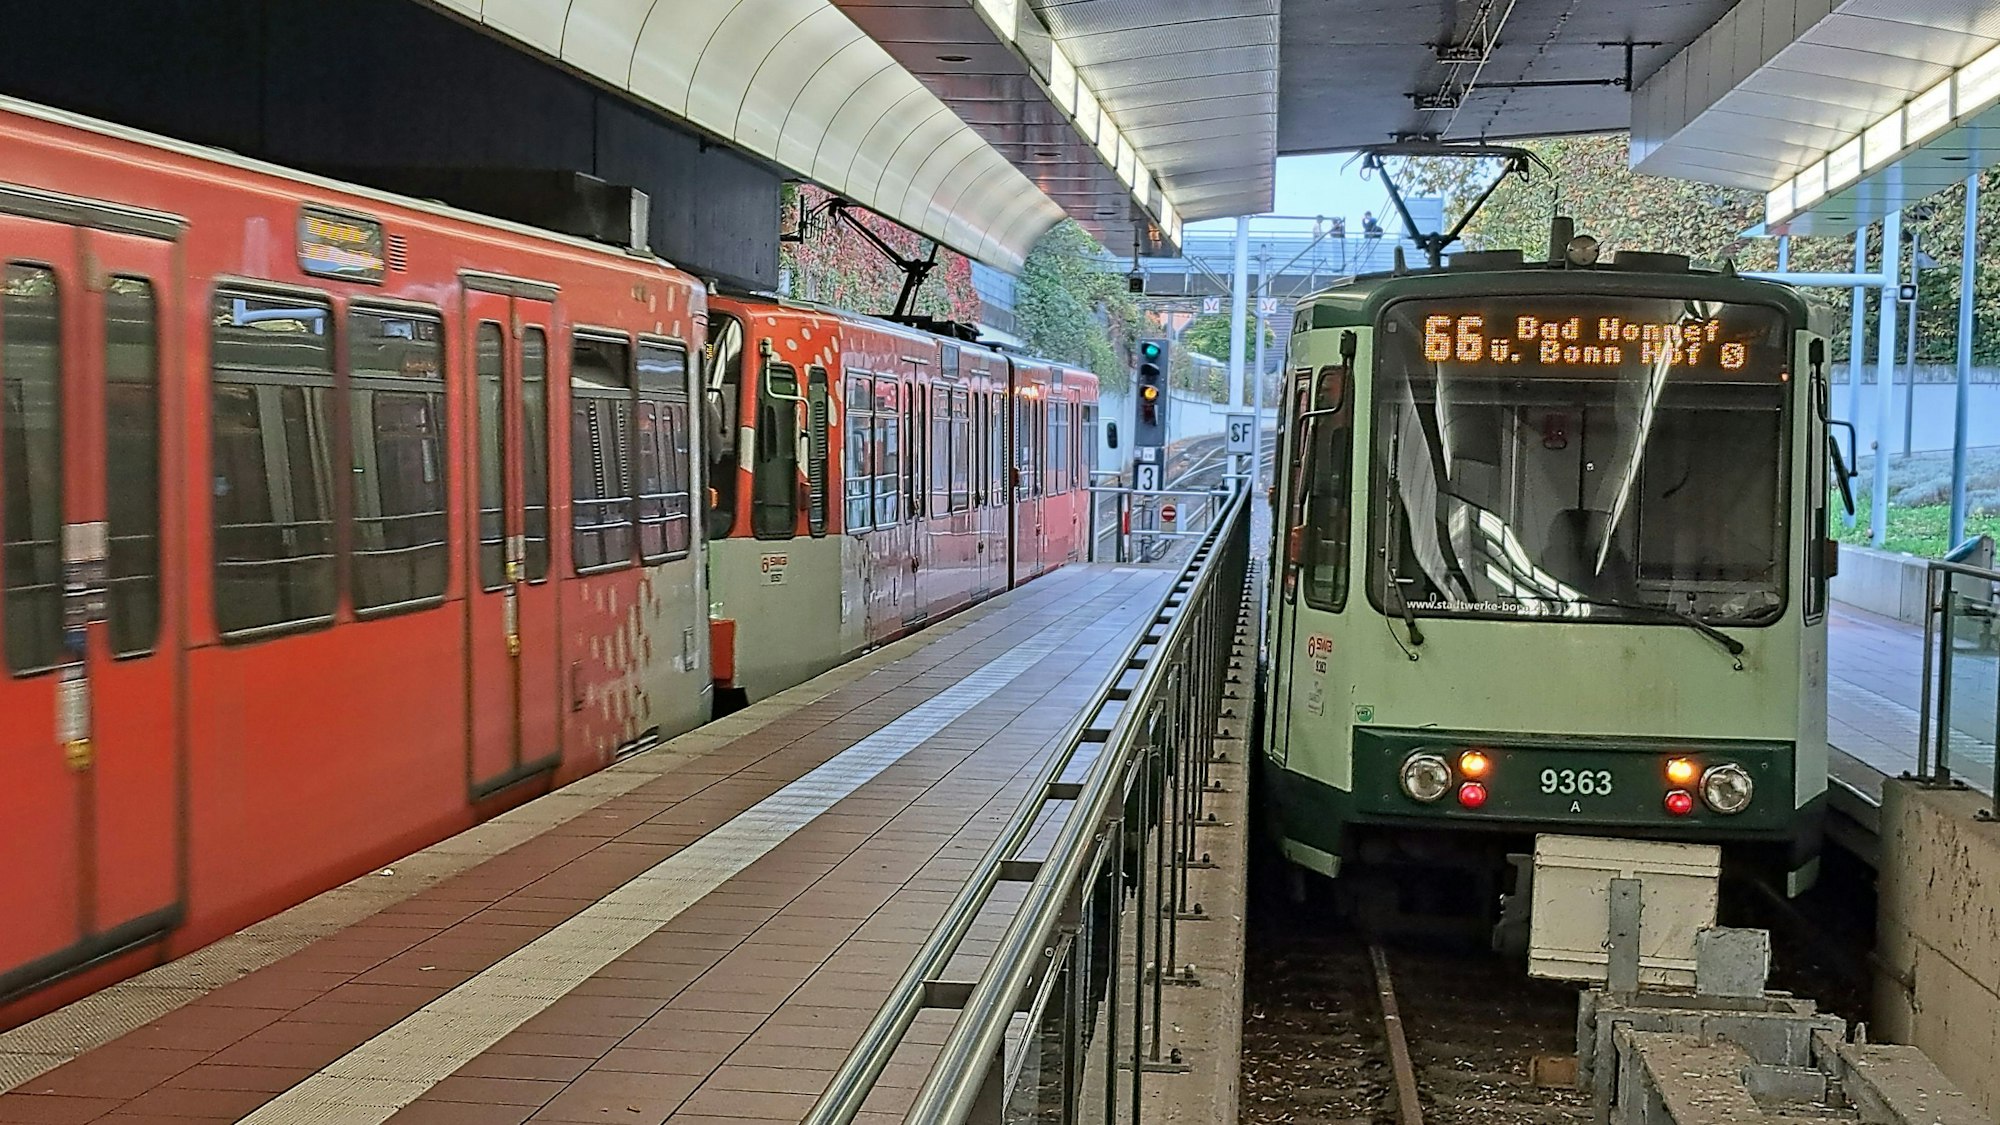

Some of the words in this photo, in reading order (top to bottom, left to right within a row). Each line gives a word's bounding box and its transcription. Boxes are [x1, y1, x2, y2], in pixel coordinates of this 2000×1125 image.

[1424, 315, 1484, 362] 66
[1517, 316, 1581, 340] Bad
[1598, 317, 1720, 342] Honnef
[1540, 339, 1621, 363] Bonn
[1231, 423, 1252, 443] SF
[1143, 467, 1153, 490] 3
[1541, 768, 1612, 796] 9363
[1570, 800, 1581, 813] A
